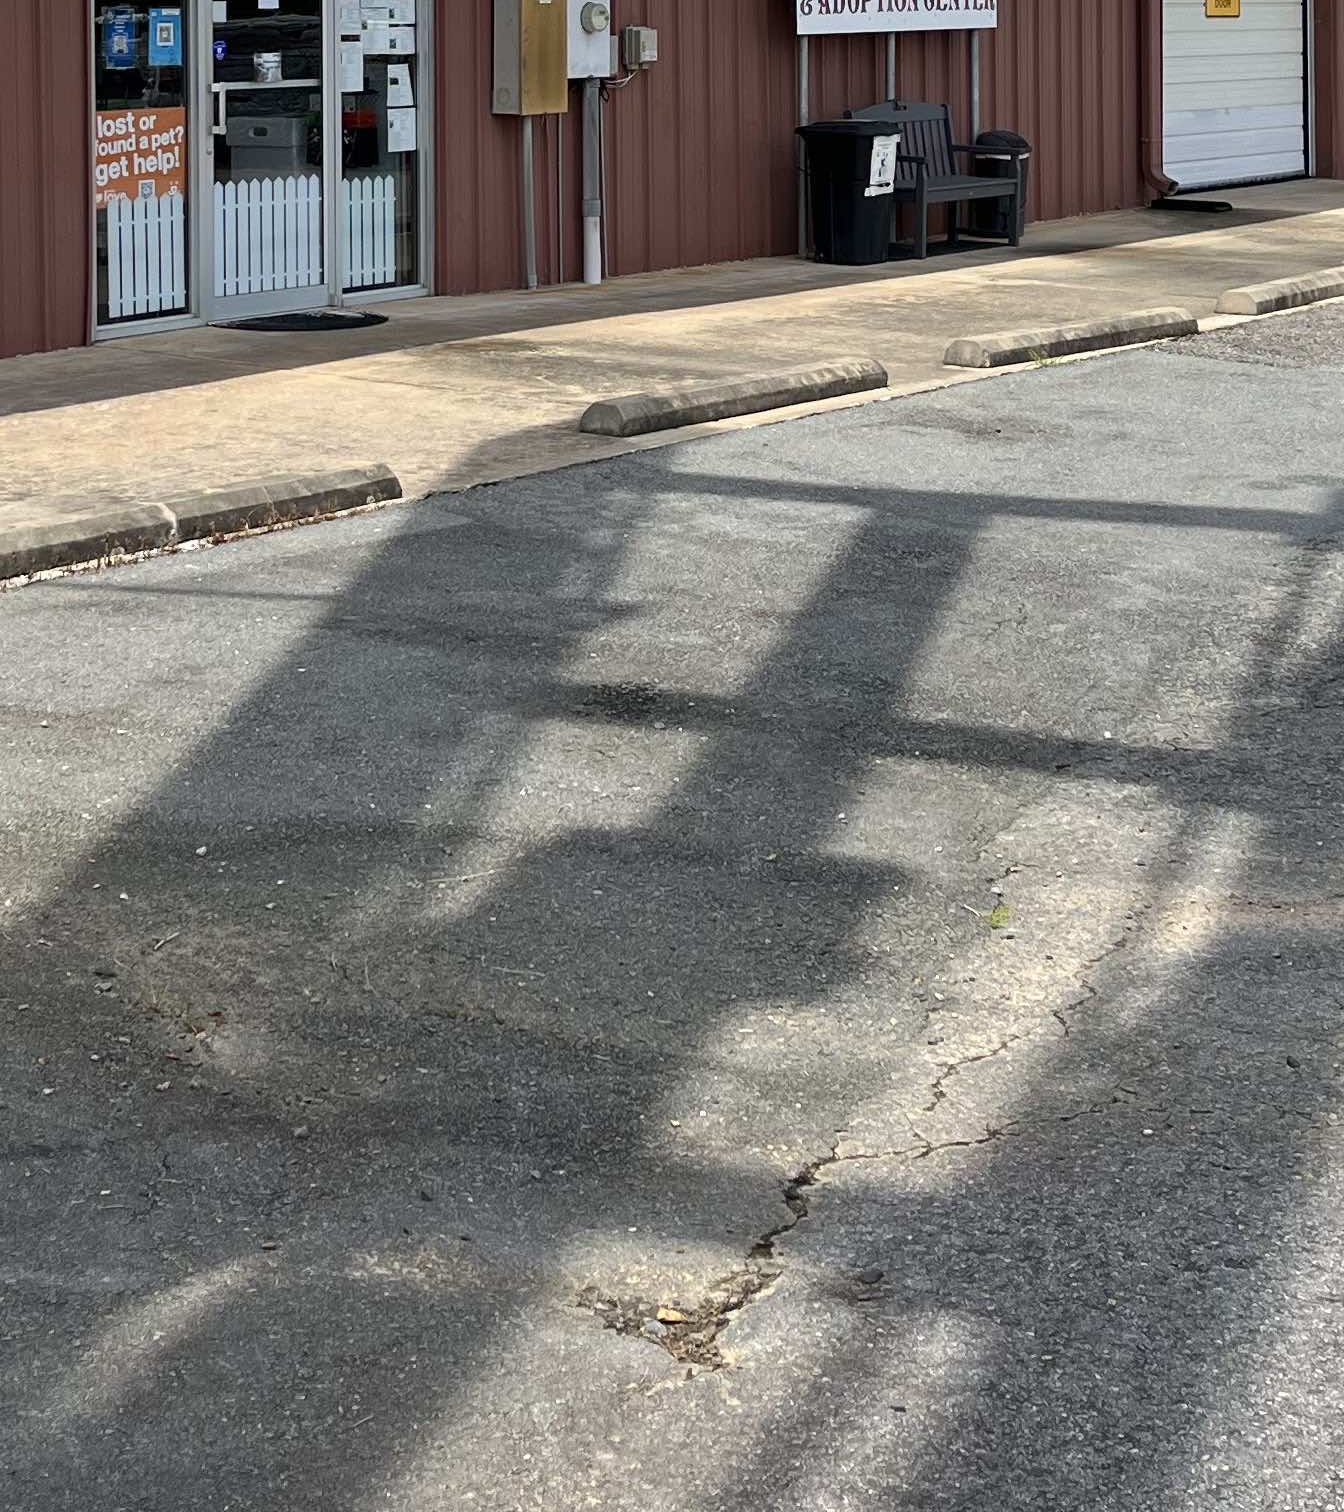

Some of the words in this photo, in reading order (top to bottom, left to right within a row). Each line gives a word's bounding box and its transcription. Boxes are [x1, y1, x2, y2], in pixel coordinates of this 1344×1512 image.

[97, 112, 135, 138] lost
[139, 115, 157, 130] or
[139, 136, 149, 149] a
[151, 126, 184, 151] pet?
[96, 156, 129, 186] get
[133, 146, 180, 175] help!
